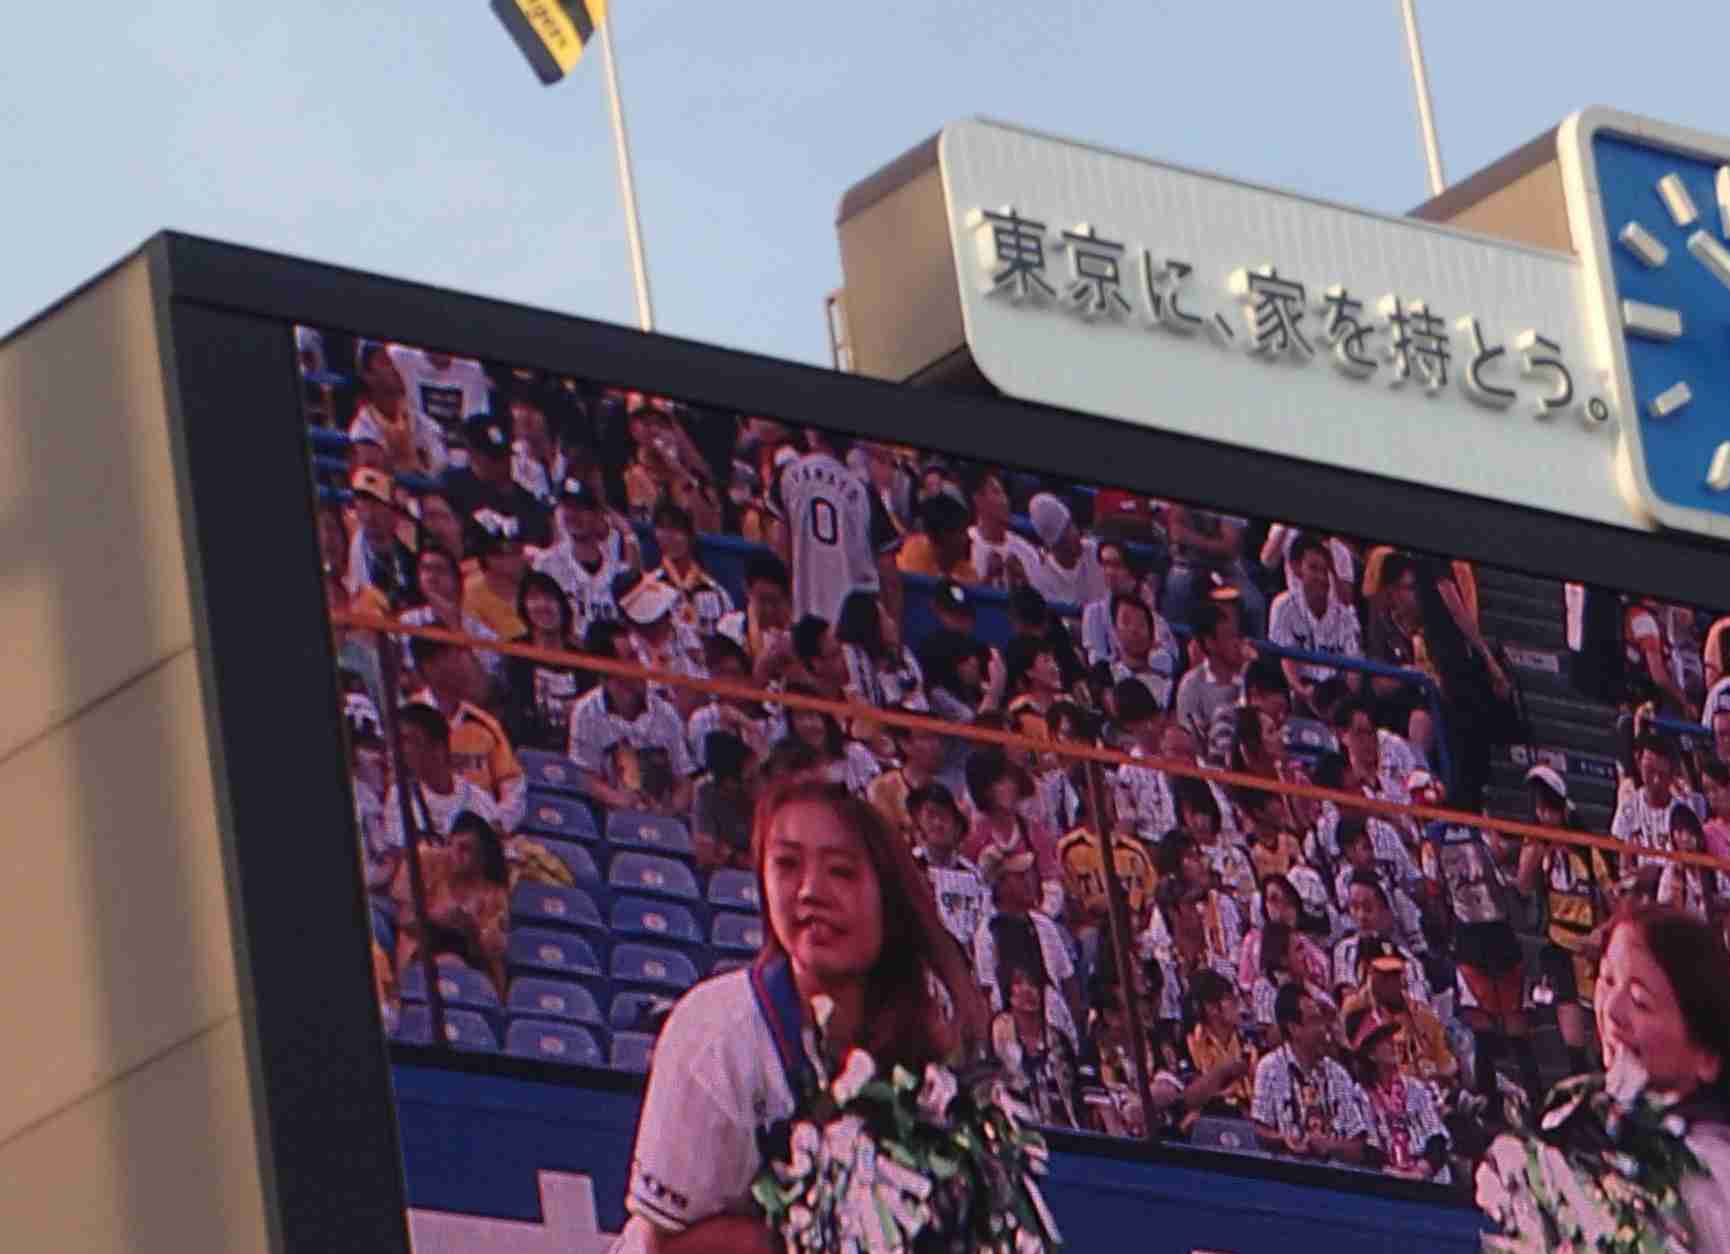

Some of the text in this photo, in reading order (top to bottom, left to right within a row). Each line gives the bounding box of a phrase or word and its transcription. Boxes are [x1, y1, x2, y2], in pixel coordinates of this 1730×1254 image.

[972, 206, 1610, 424] 東京に、家を持とう。
